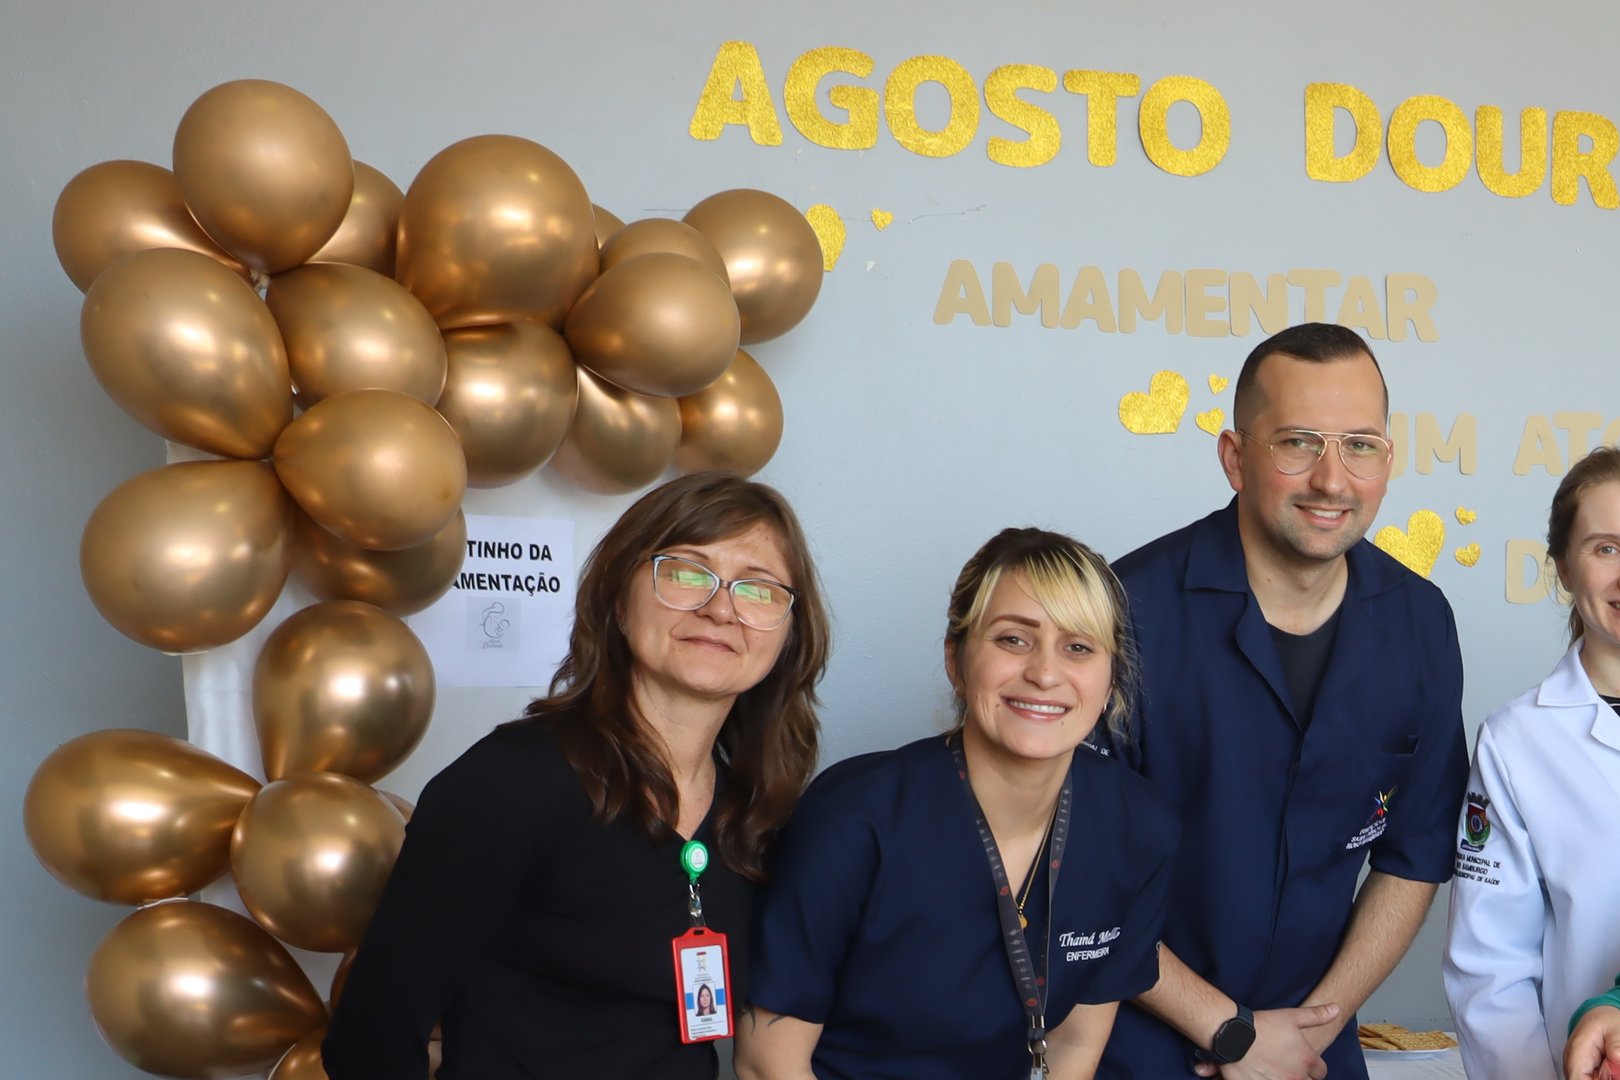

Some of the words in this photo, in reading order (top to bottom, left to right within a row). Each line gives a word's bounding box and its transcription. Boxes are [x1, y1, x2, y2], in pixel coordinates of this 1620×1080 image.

[689, 40, 1231, 177] AGOSTO
[932, 259, 1439, 343] AMAMENTAR
[529, 543, 553, 562] DA
[1504, 538, 1574, 606] D
